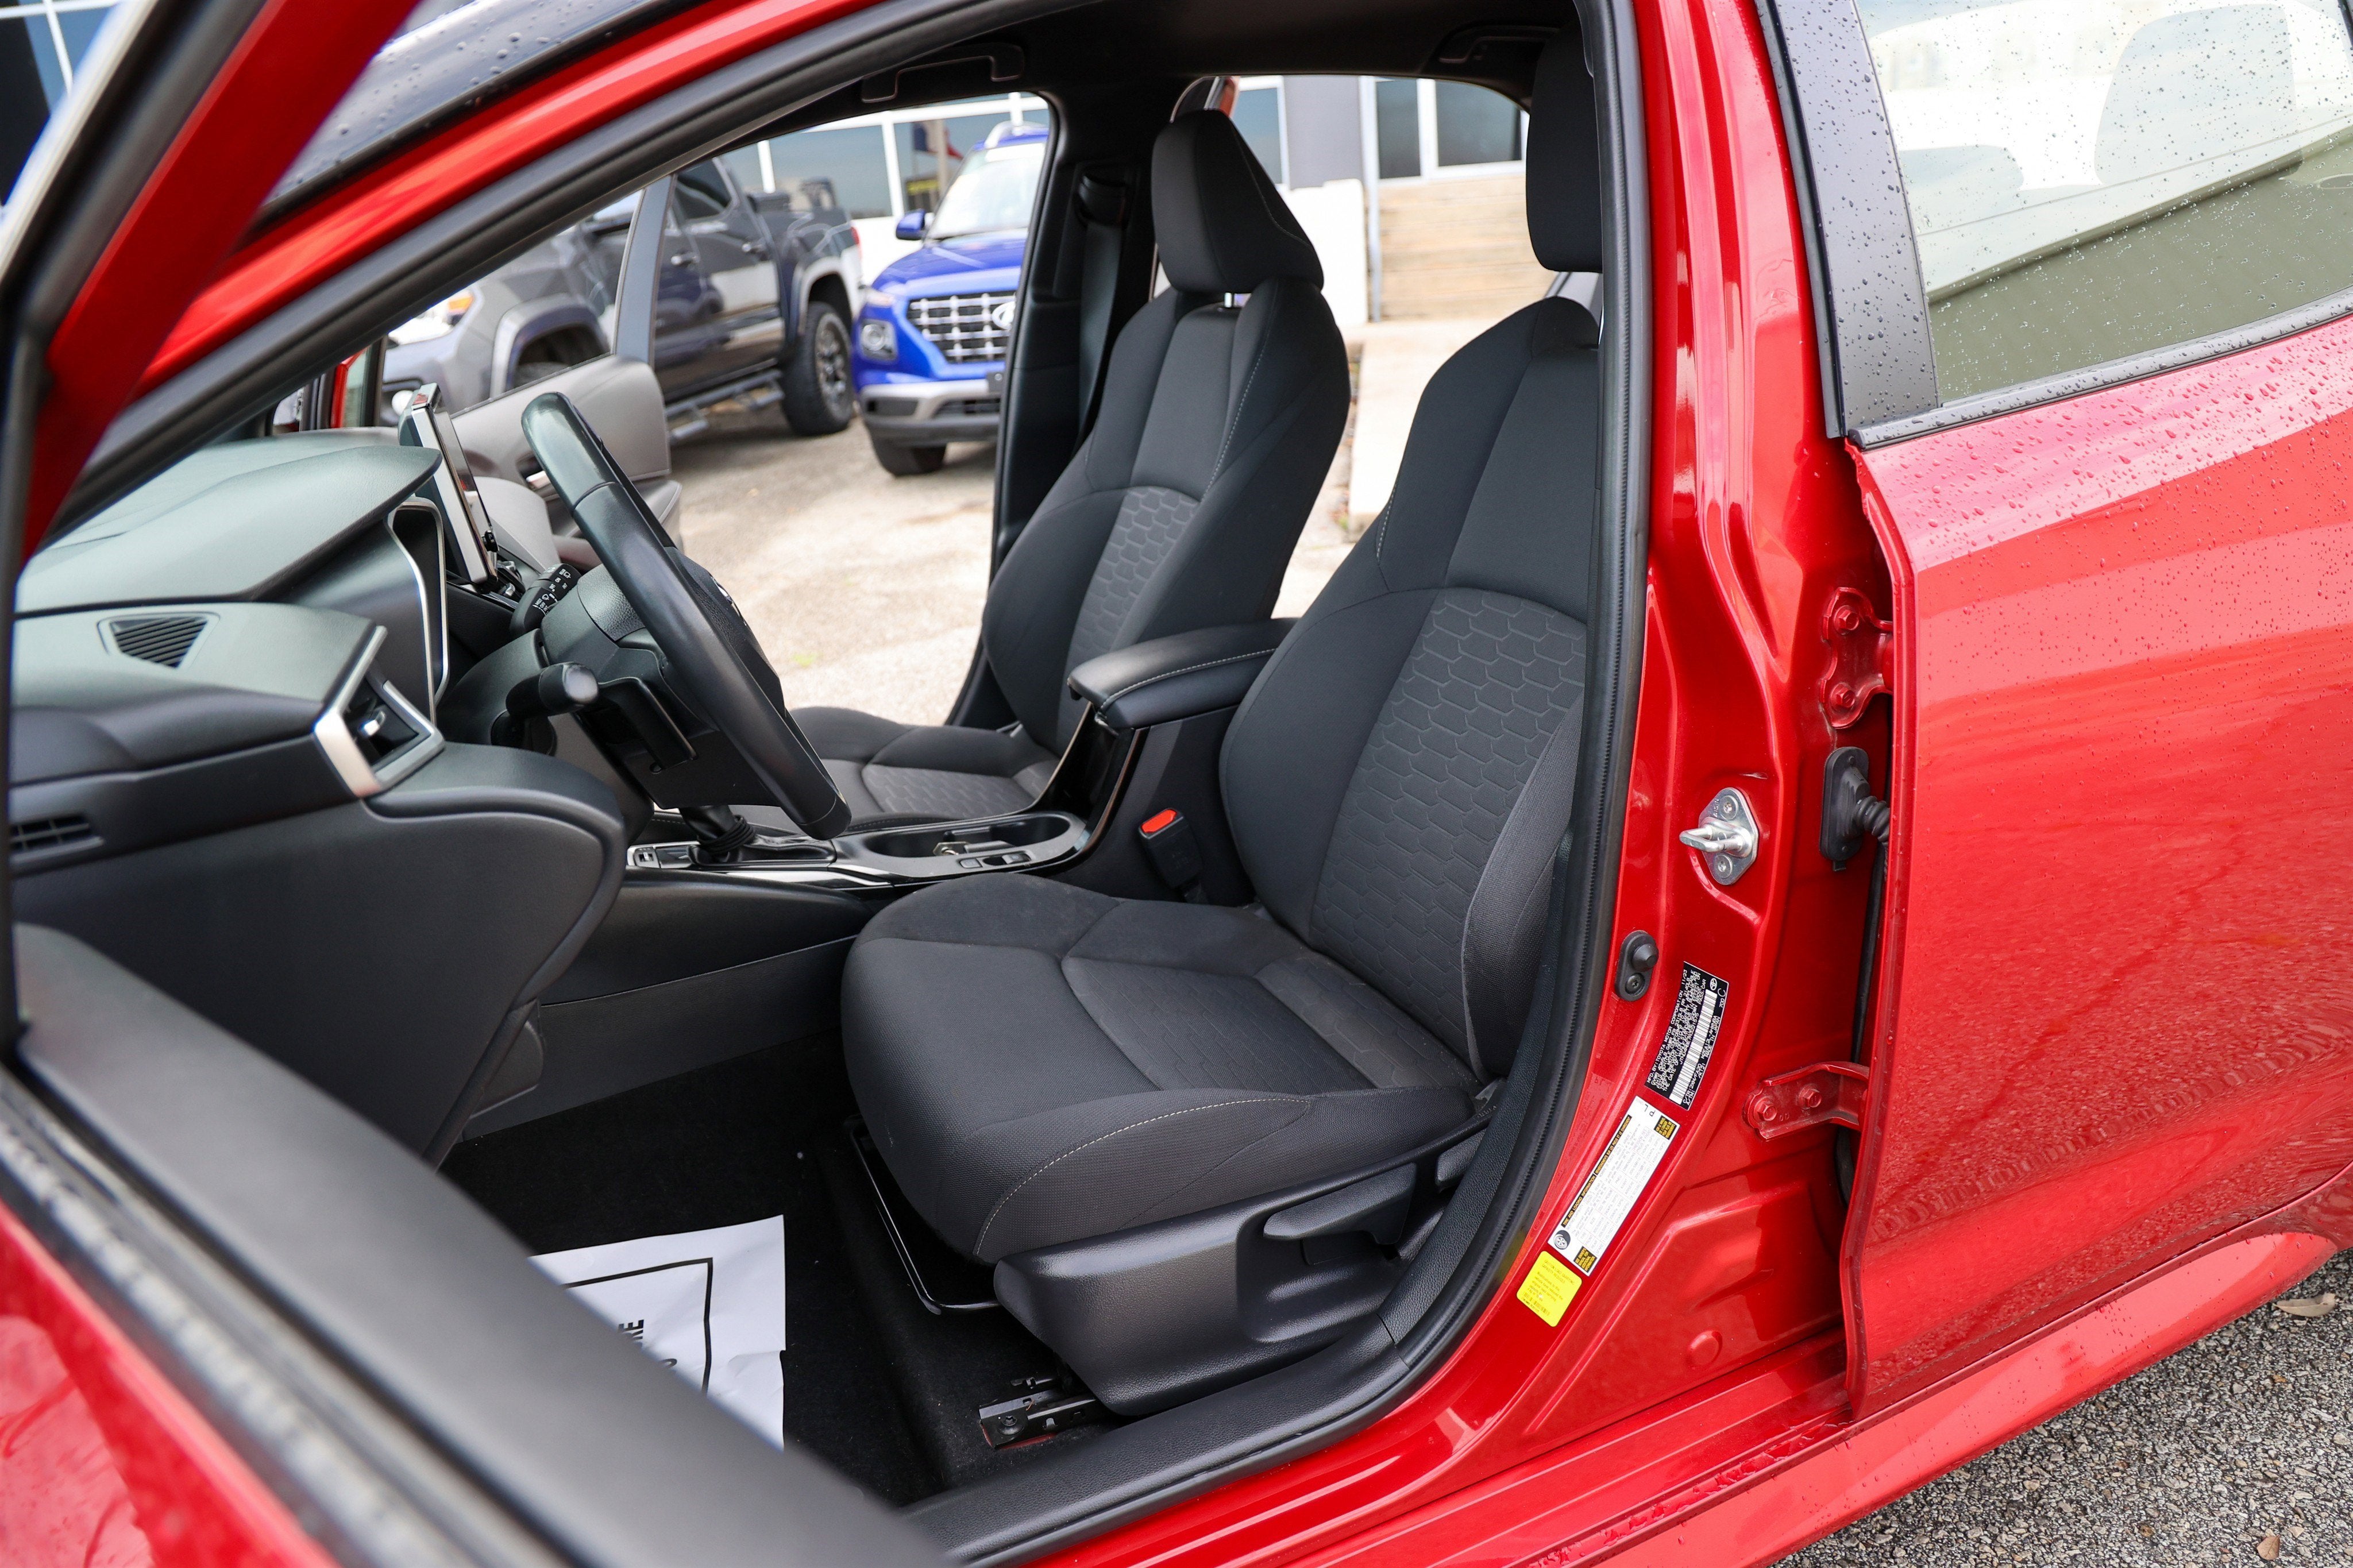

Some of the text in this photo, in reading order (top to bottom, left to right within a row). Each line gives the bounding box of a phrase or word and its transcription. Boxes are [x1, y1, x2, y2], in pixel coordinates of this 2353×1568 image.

[1653, 1073, 1662, 1087] THIS
[1660, 1050, 1672, 1072] VEHICLE
[1669, 1023, 1681, 1049] CONFORMS
[1685, 970, 1695, 1001] APPLICABLE
[1664, 1025, 1672, 1042] MOTOR
[1670, 990, 1683, 1025] CORPORATION
[1650, 1072, 1659, 1085] GVWR
[1656, 1068, 1668, 1088] FEDERAL
[1667, 1048, 1676, 1065] MOTOR
[1674, 1025, 1684, 1048] VEHICLE
[1659, 1075, 1669, 1090] THEFT
[1667, 1041, 1682, 1073] PREVENTION
[1680, 1011, 1692, 1041] STANDARDS
[1668, 1067, 1676, 1080] DATE
[1677, 1022, 1692, 1057] MANUFACTURE
[1572, 1196, 1583, 1211] LOADING
[1581, 1175, 1596, 1197] INFORMATION
